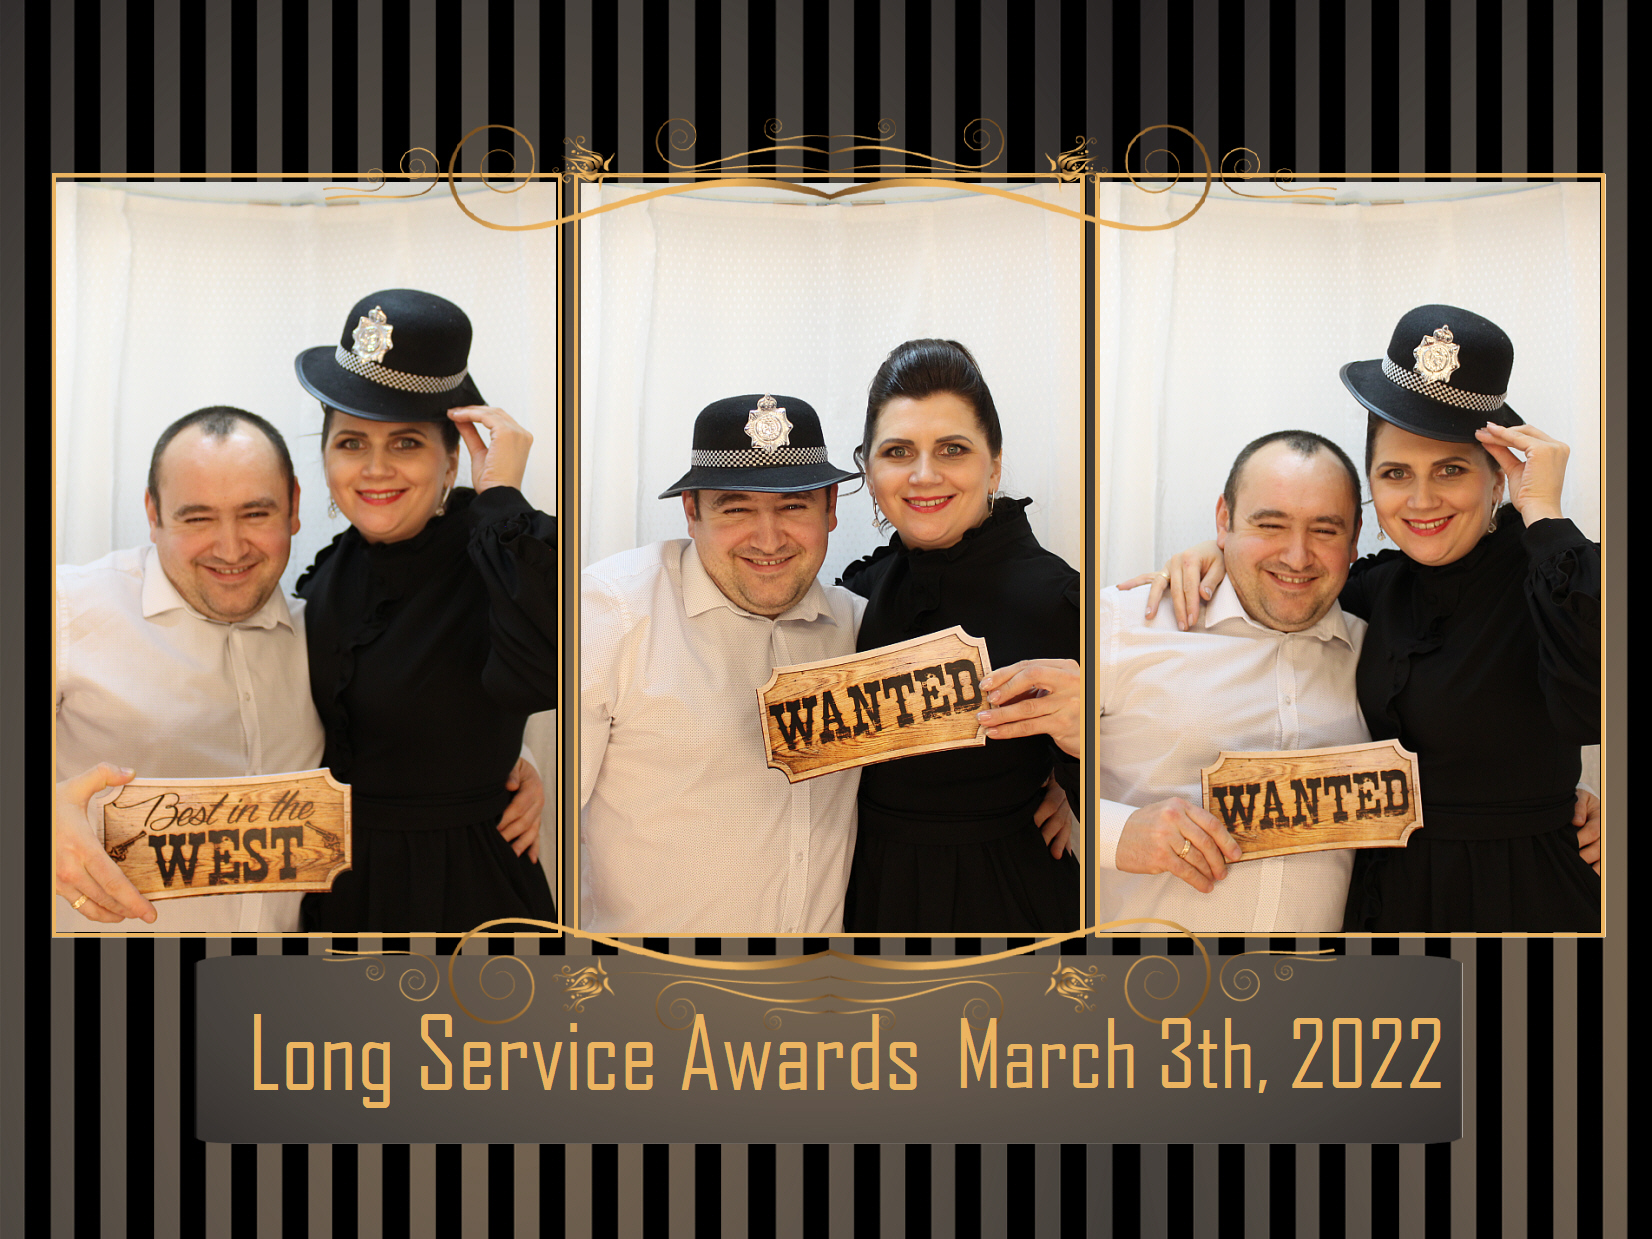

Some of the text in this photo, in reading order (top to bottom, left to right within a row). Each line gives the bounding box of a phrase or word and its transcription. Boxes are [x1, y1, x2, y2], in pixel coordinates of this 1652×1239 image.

[769, 659, 983, 751] WANTED
[112, 790, 316, 831] Best in the
[1212, 769, 1409, 832] WANTED
[148, 825, 303, 888] WEST
